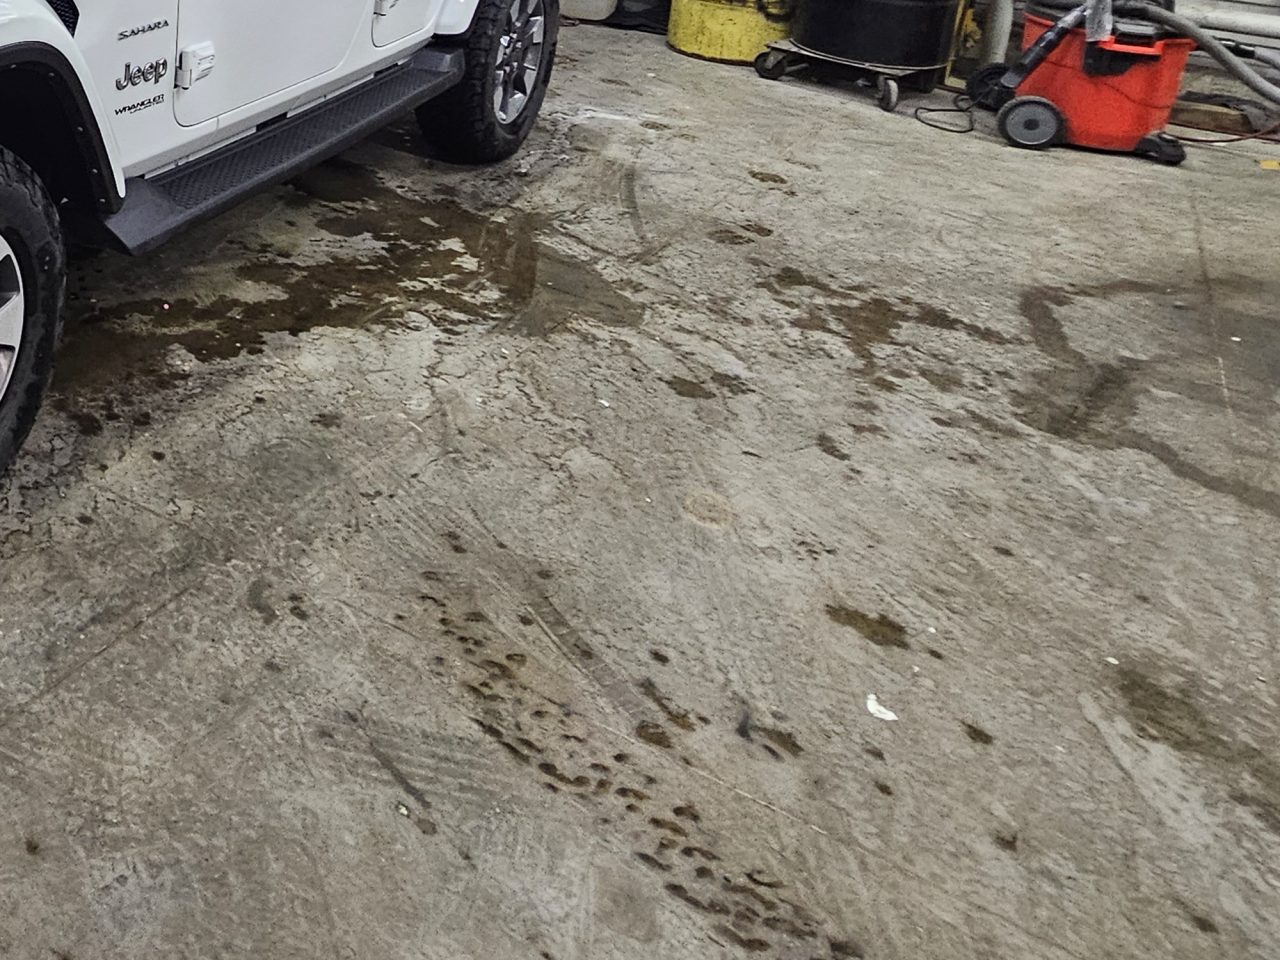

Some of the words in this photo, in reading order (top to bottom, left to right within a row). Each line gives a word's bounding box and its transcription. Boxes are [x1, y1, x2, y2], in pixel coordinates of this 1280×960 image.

[117, 19, 170, 41] SAHARA
[115, 58, 168, 91] Jeep
[114, 93, 165, 116] WRANGLER
